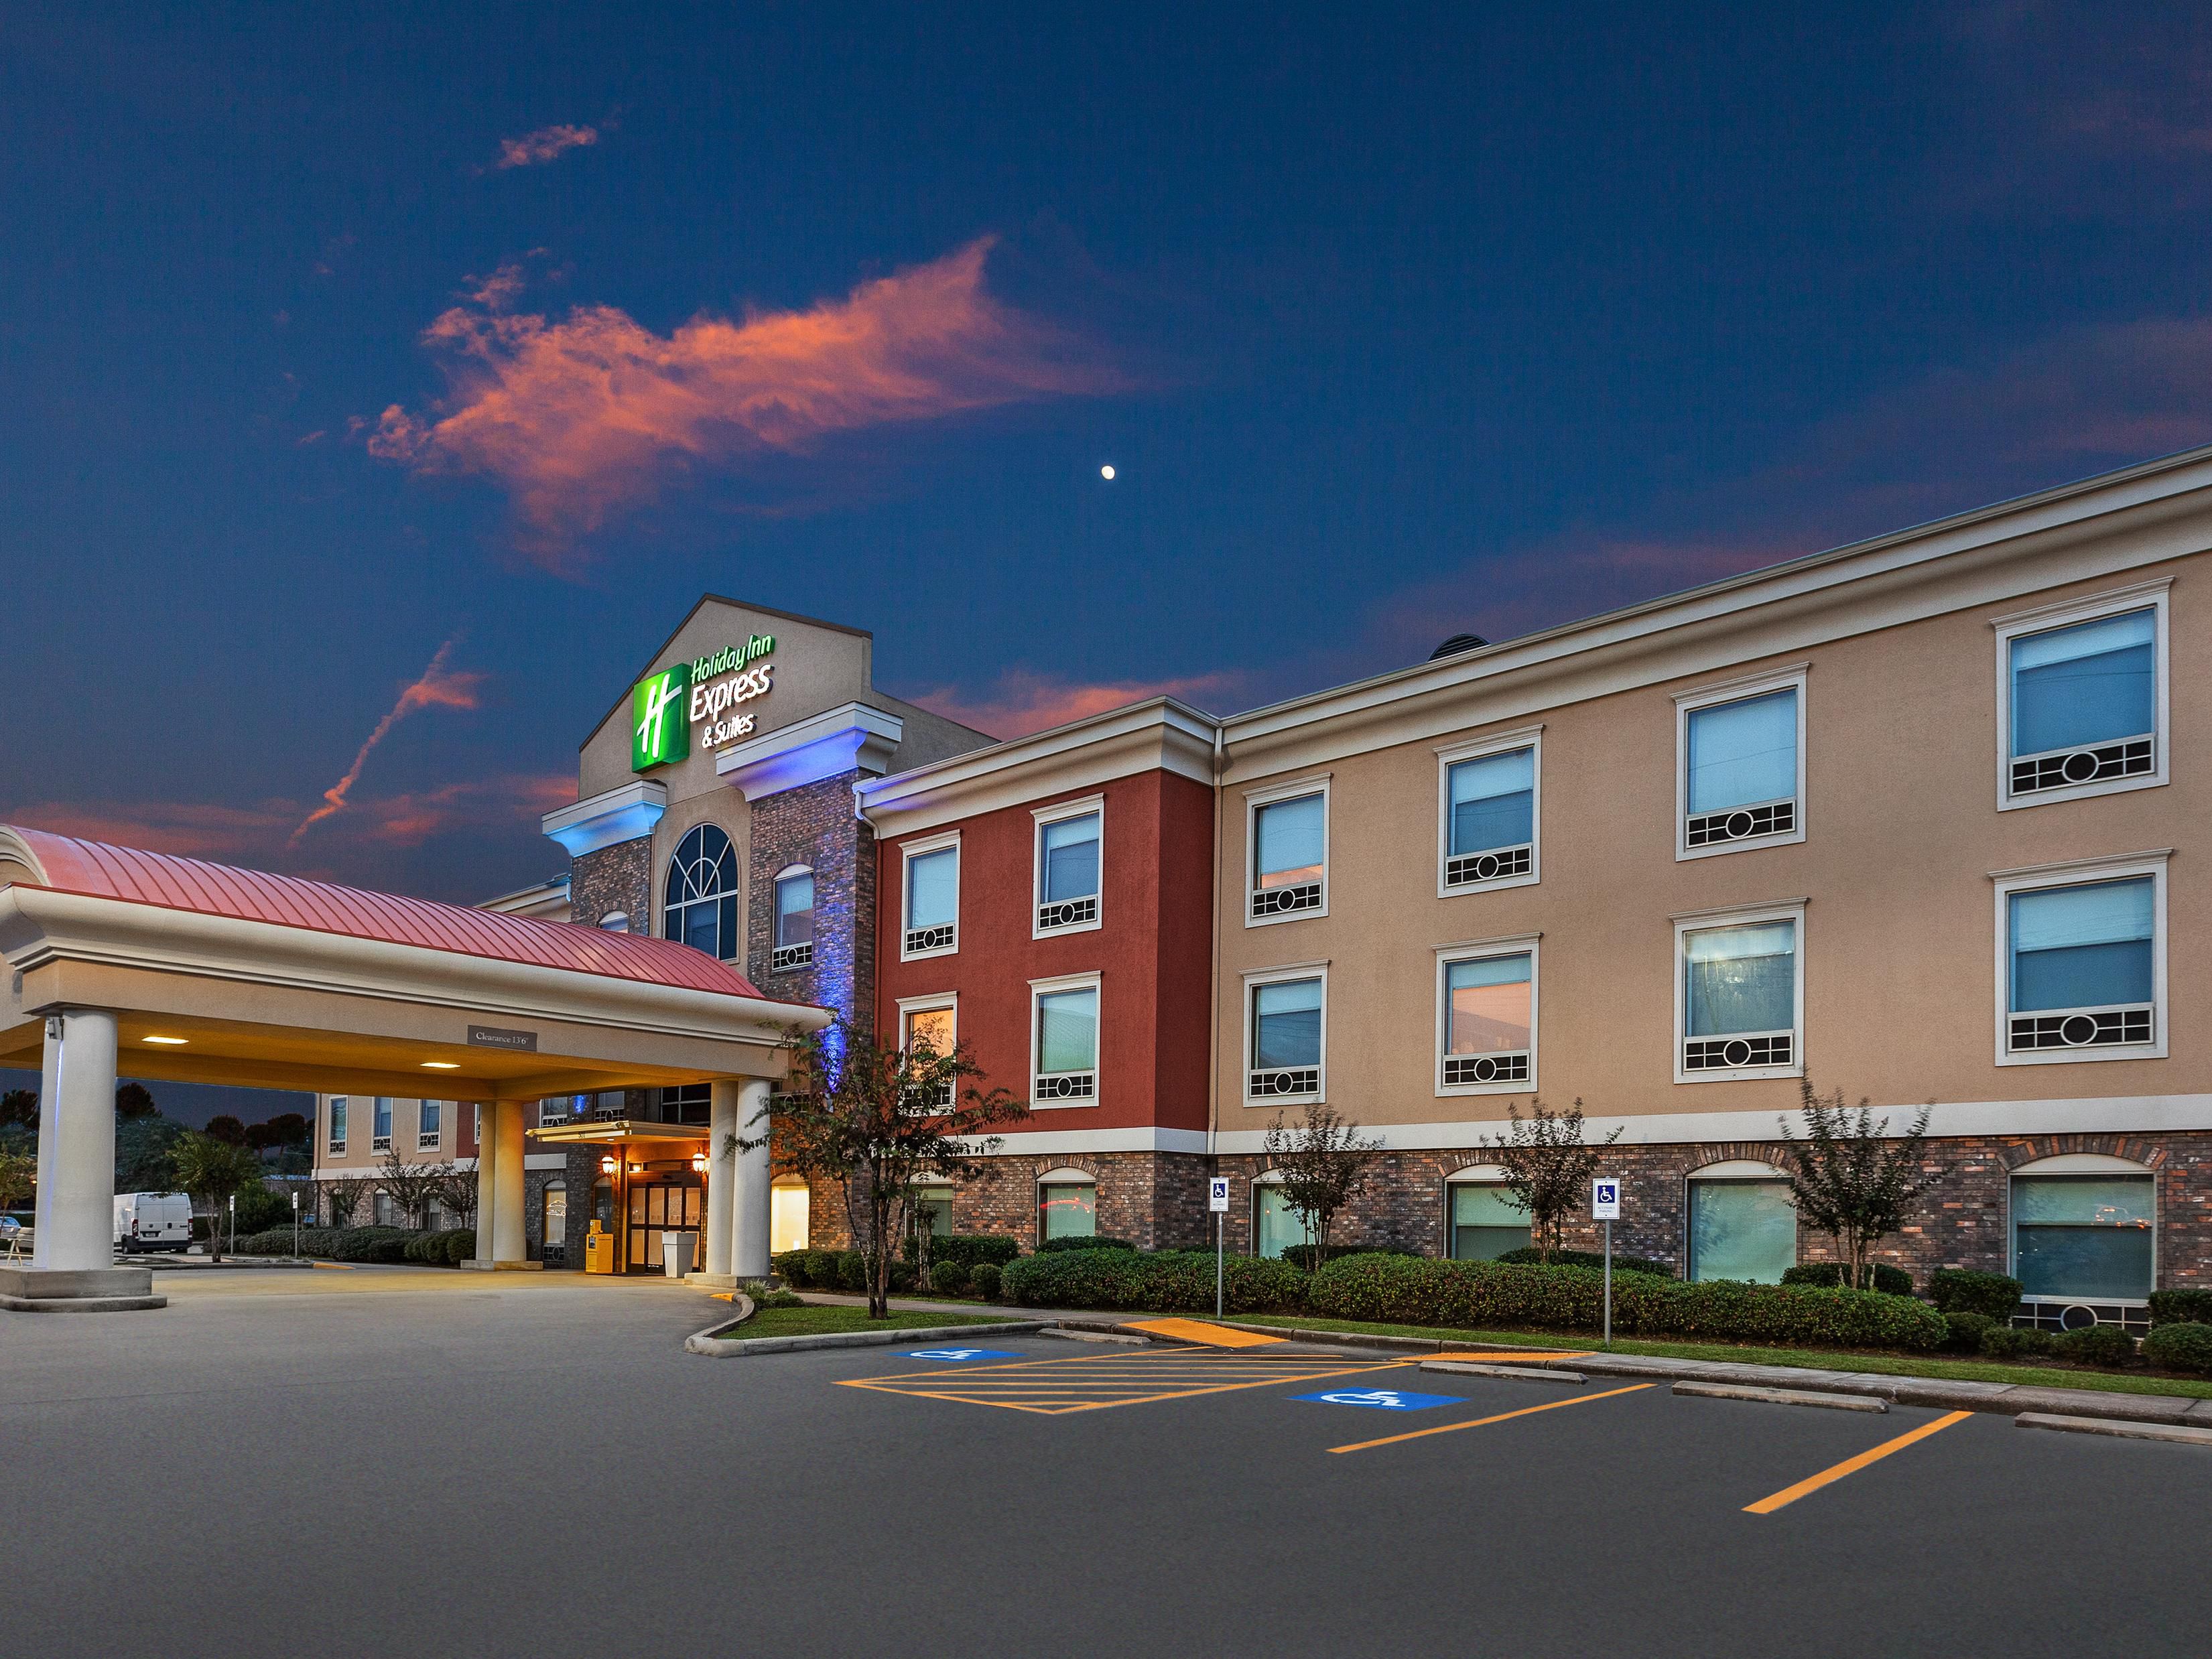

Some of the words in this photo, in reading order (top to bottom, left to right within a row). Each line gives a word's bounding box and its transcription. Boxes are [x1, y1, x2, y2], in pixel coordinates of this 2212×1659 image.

[690, 645, 746, 684] Holiday
[747, 634, 773, 660] Inn
[690, 664, 772, 722] Express
[701, 726, 714, 748] &
[714, 713, 756, 744] Suites
[476, 1032, 511, 1043] Clearance
